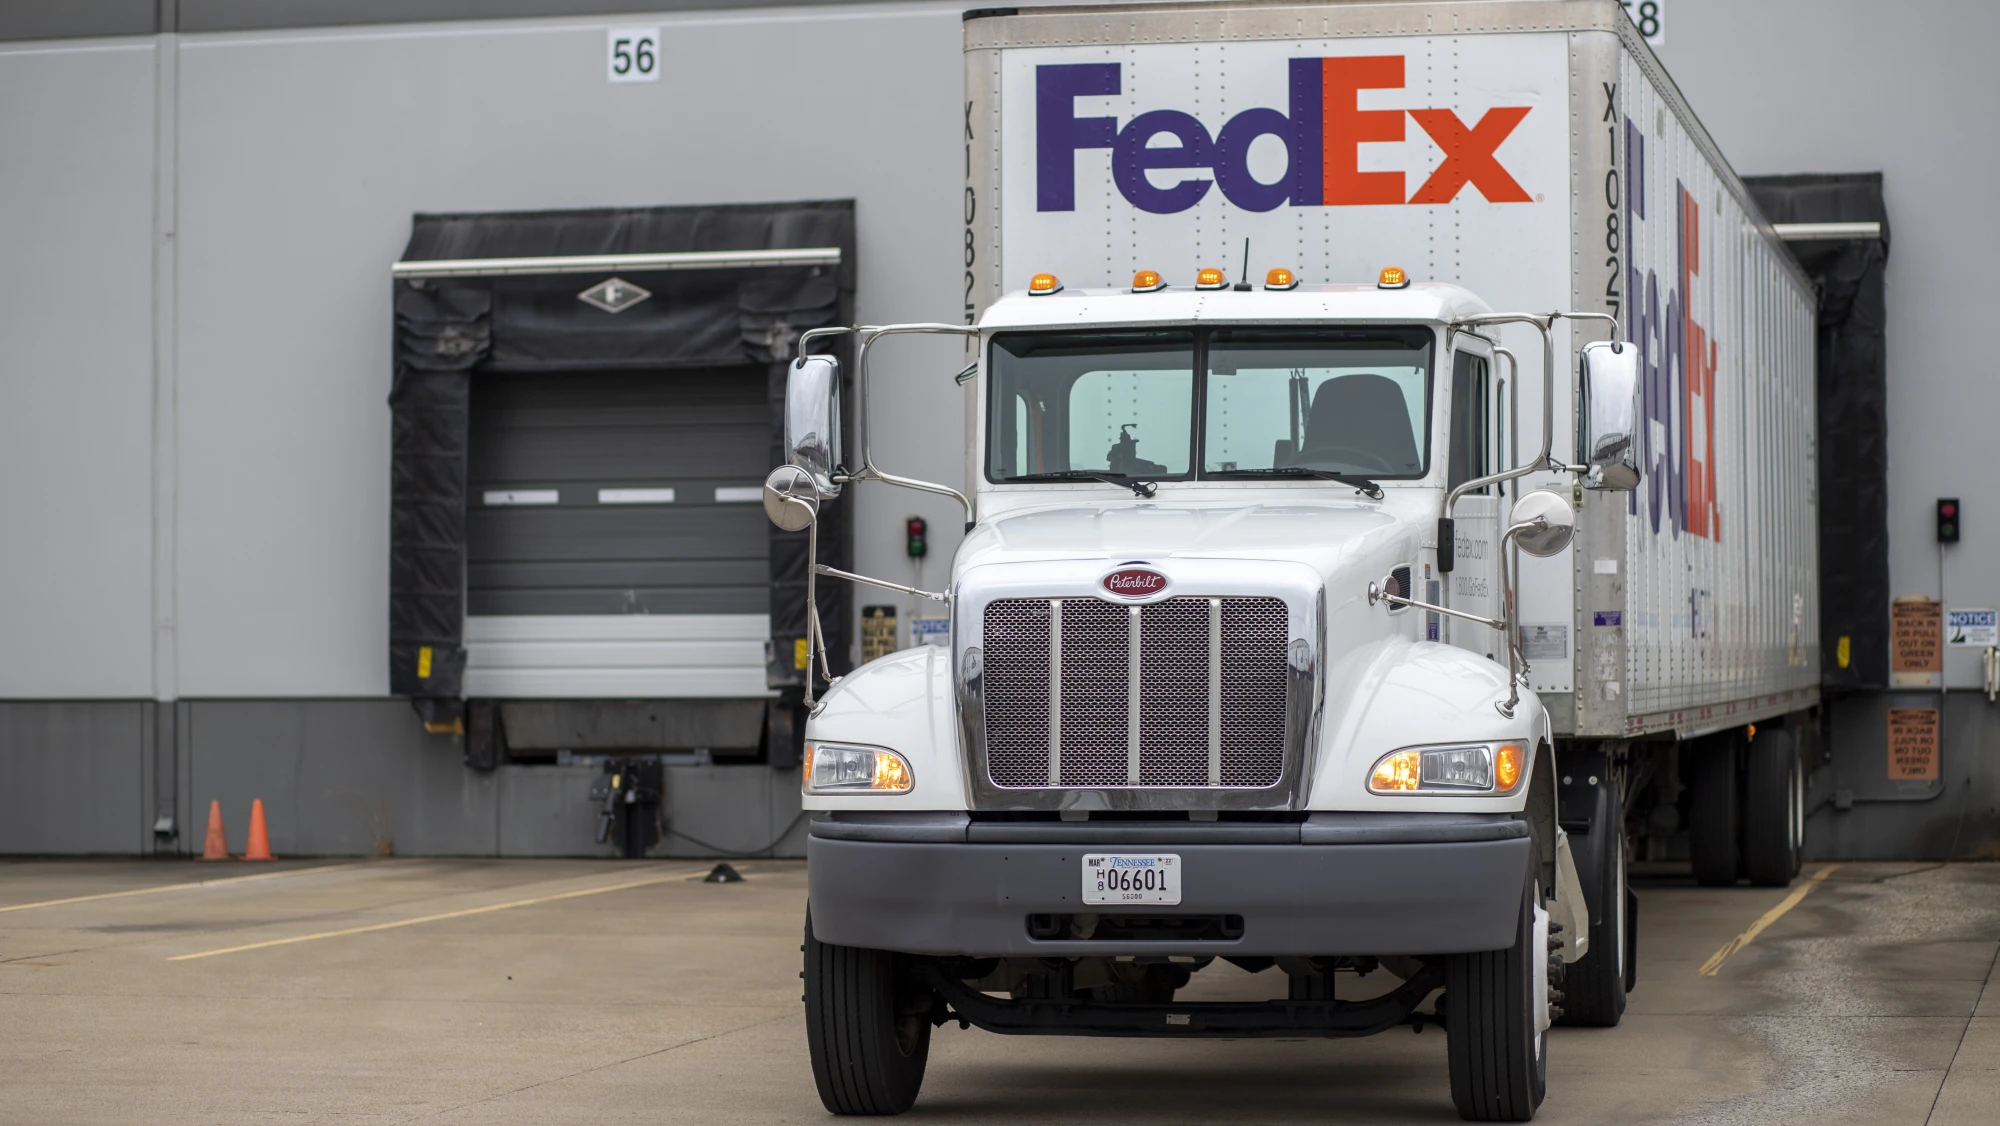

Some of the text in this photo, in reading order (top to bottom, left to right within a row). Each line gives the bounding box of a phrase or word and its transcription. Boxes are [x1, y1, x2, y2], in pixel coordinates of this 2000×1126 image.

[1621, 1, 1660, 37] 8
[613, 37, 655, 75] 56
[1036, 55, 1533, 213] FedEx
[1602, 82, 1620, 340] X10827
[1624, 114, 1720, 542] FedEx
[1109, 574, 1161, 589] Peterbilt
[1950, 612, 1995, 625] NOTICE
[914, 620, 949, 633] NOTIC
[1896, 629, 1936, 637] OR PULL
[1898, 639, 1936, 647] OUT ON
[1900, 649, 1934, 657] GREEN
[1904, 659, 1930, 668] ONLY
[1088, 859, 1100, 867] MAR
[1109, 857, 1155, 868] TENNESSEE
[1108, 869, 1166, 891] 06601
